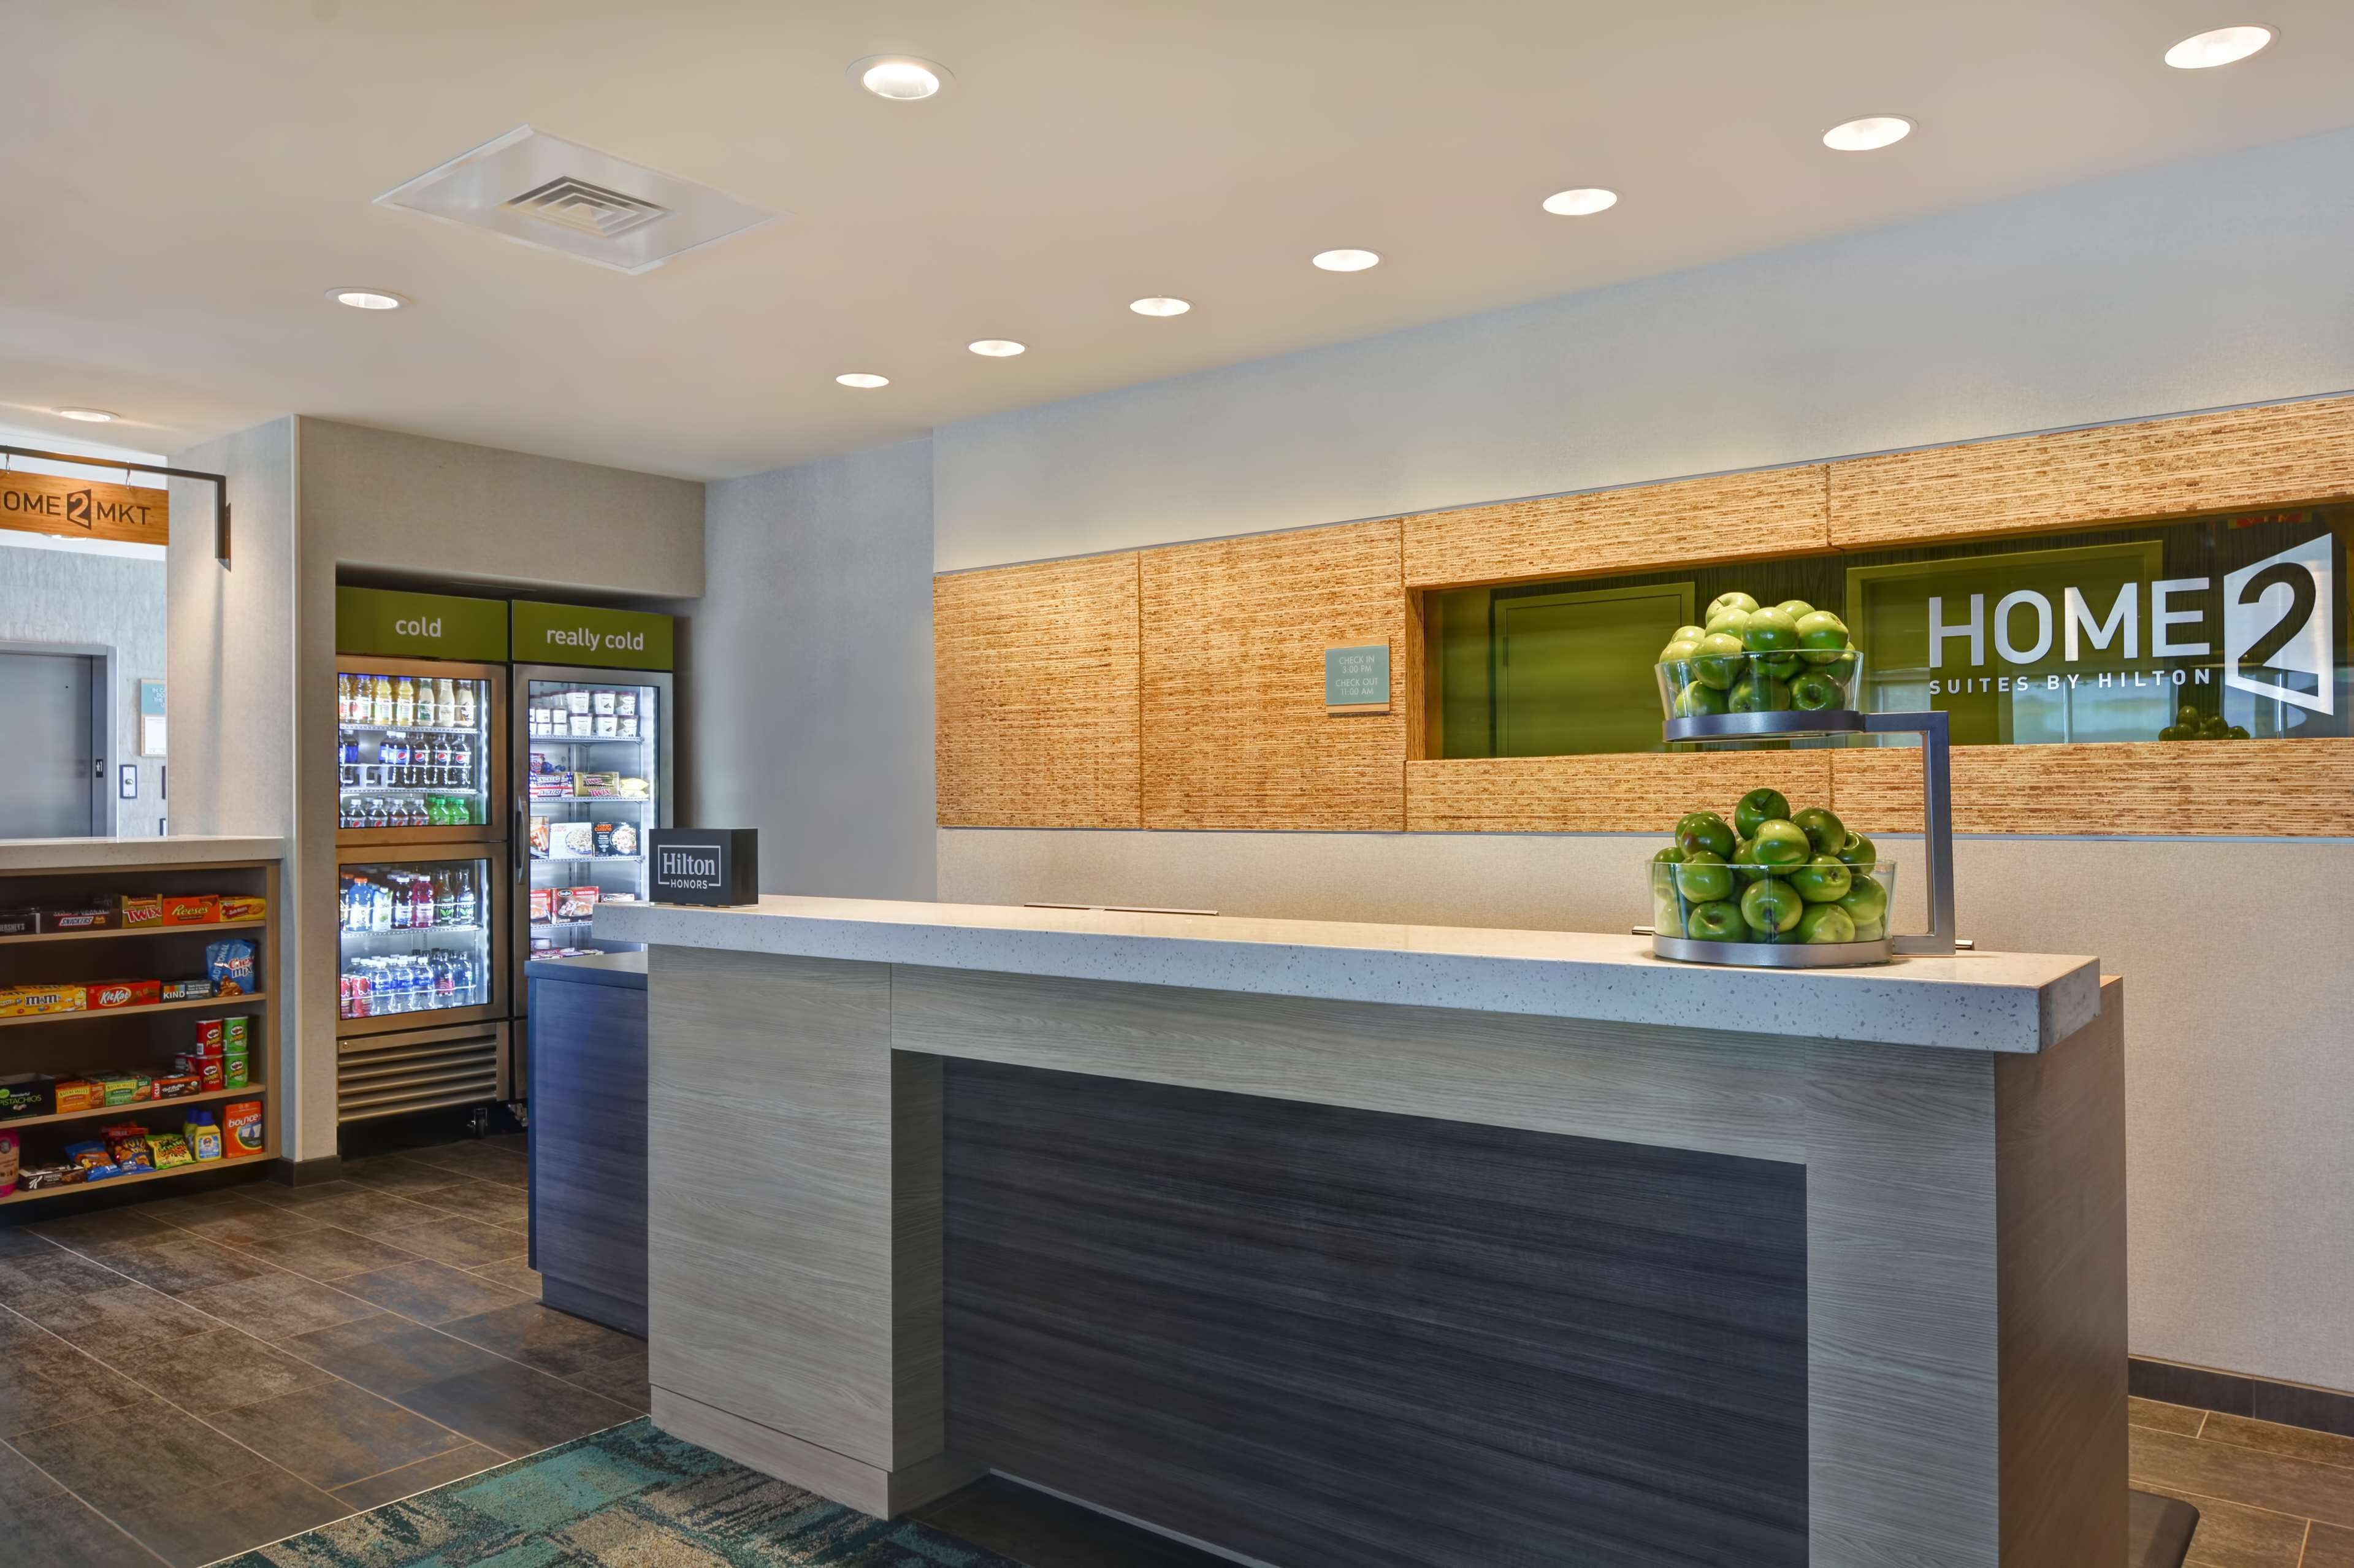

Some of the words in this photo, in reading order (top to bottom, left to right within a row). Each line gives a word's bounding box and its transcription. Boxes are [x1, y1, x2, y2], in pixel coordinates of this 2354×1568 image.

[97, 502, 151, 525] MKT
[395, 617, 441, 638] cold
[1929, 577, 2211, 669] HOME
[2237, 560, 2320, 699] 2
[546, 627, 600, 651] really
[605, 632, 644, 651] cold
[1362, 677, 1378, 686] OUT
[1929, 676, 2030, 695] SUITES
[2047, 673, 2079, 690] BY
[2098, 668, 2211, 689] HILTON
[663, 852, 716, 876] Hilton
[671, 879, 708, 889] HONORS
[60, 917, 93, 926] SNICKERS
[229, 957, 253, 969] Chex
[163, 991, 185, 1000] KIND
[228, 1113, 259, 1128] bounce
